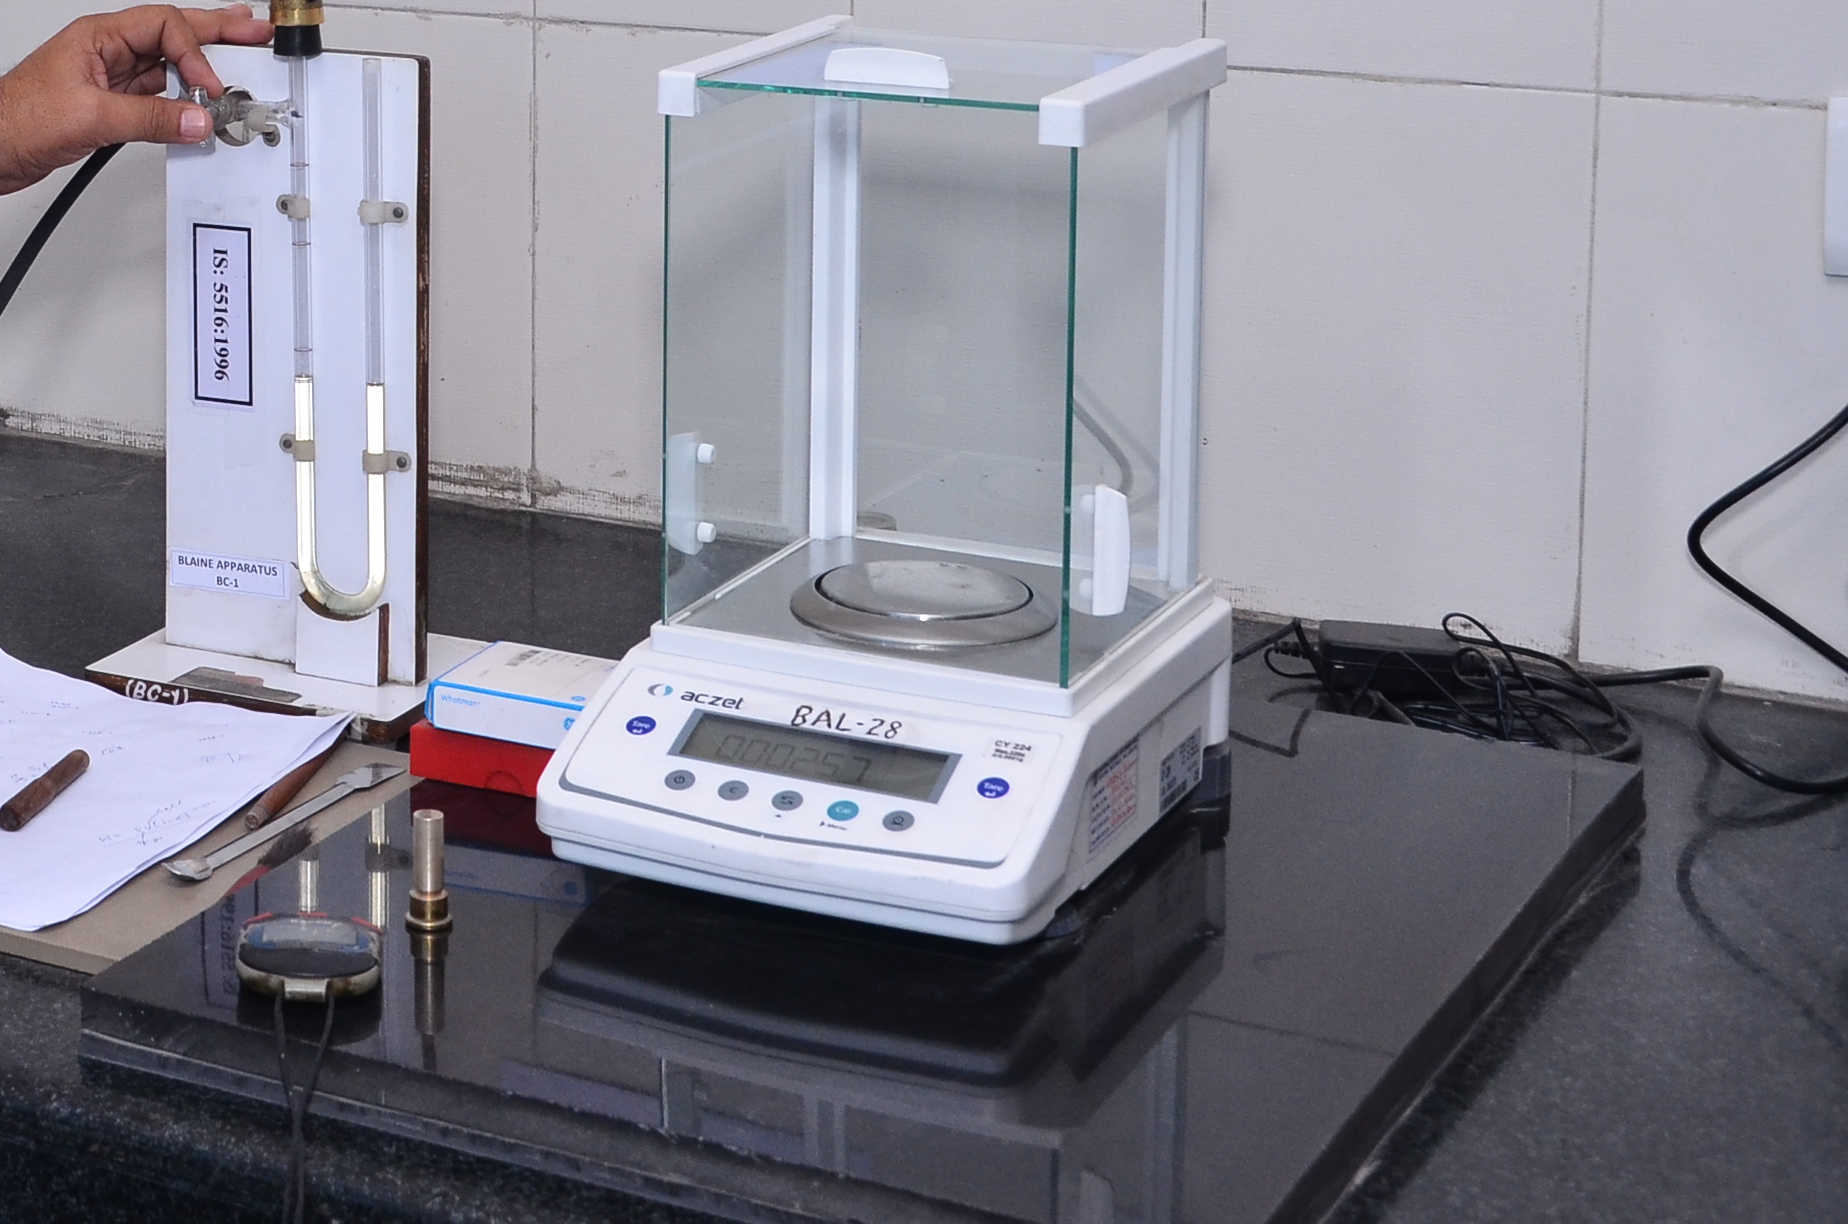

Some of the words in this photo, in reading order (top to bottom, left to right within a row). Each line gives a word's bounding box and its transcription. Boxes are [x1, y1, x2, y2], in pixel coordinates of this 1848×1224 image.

[212, 281, 232, 382] 5516:1996
[177, 555, 215, 571] BLAINE
[216, 559, 278, 576] APPARATUS
[215, 575, 239, 589] BC-1
[631, 720, 652, 730] Tare
[790, 705, 903, 739] BAL-28
[983, 782, 1004, 792] Tare
